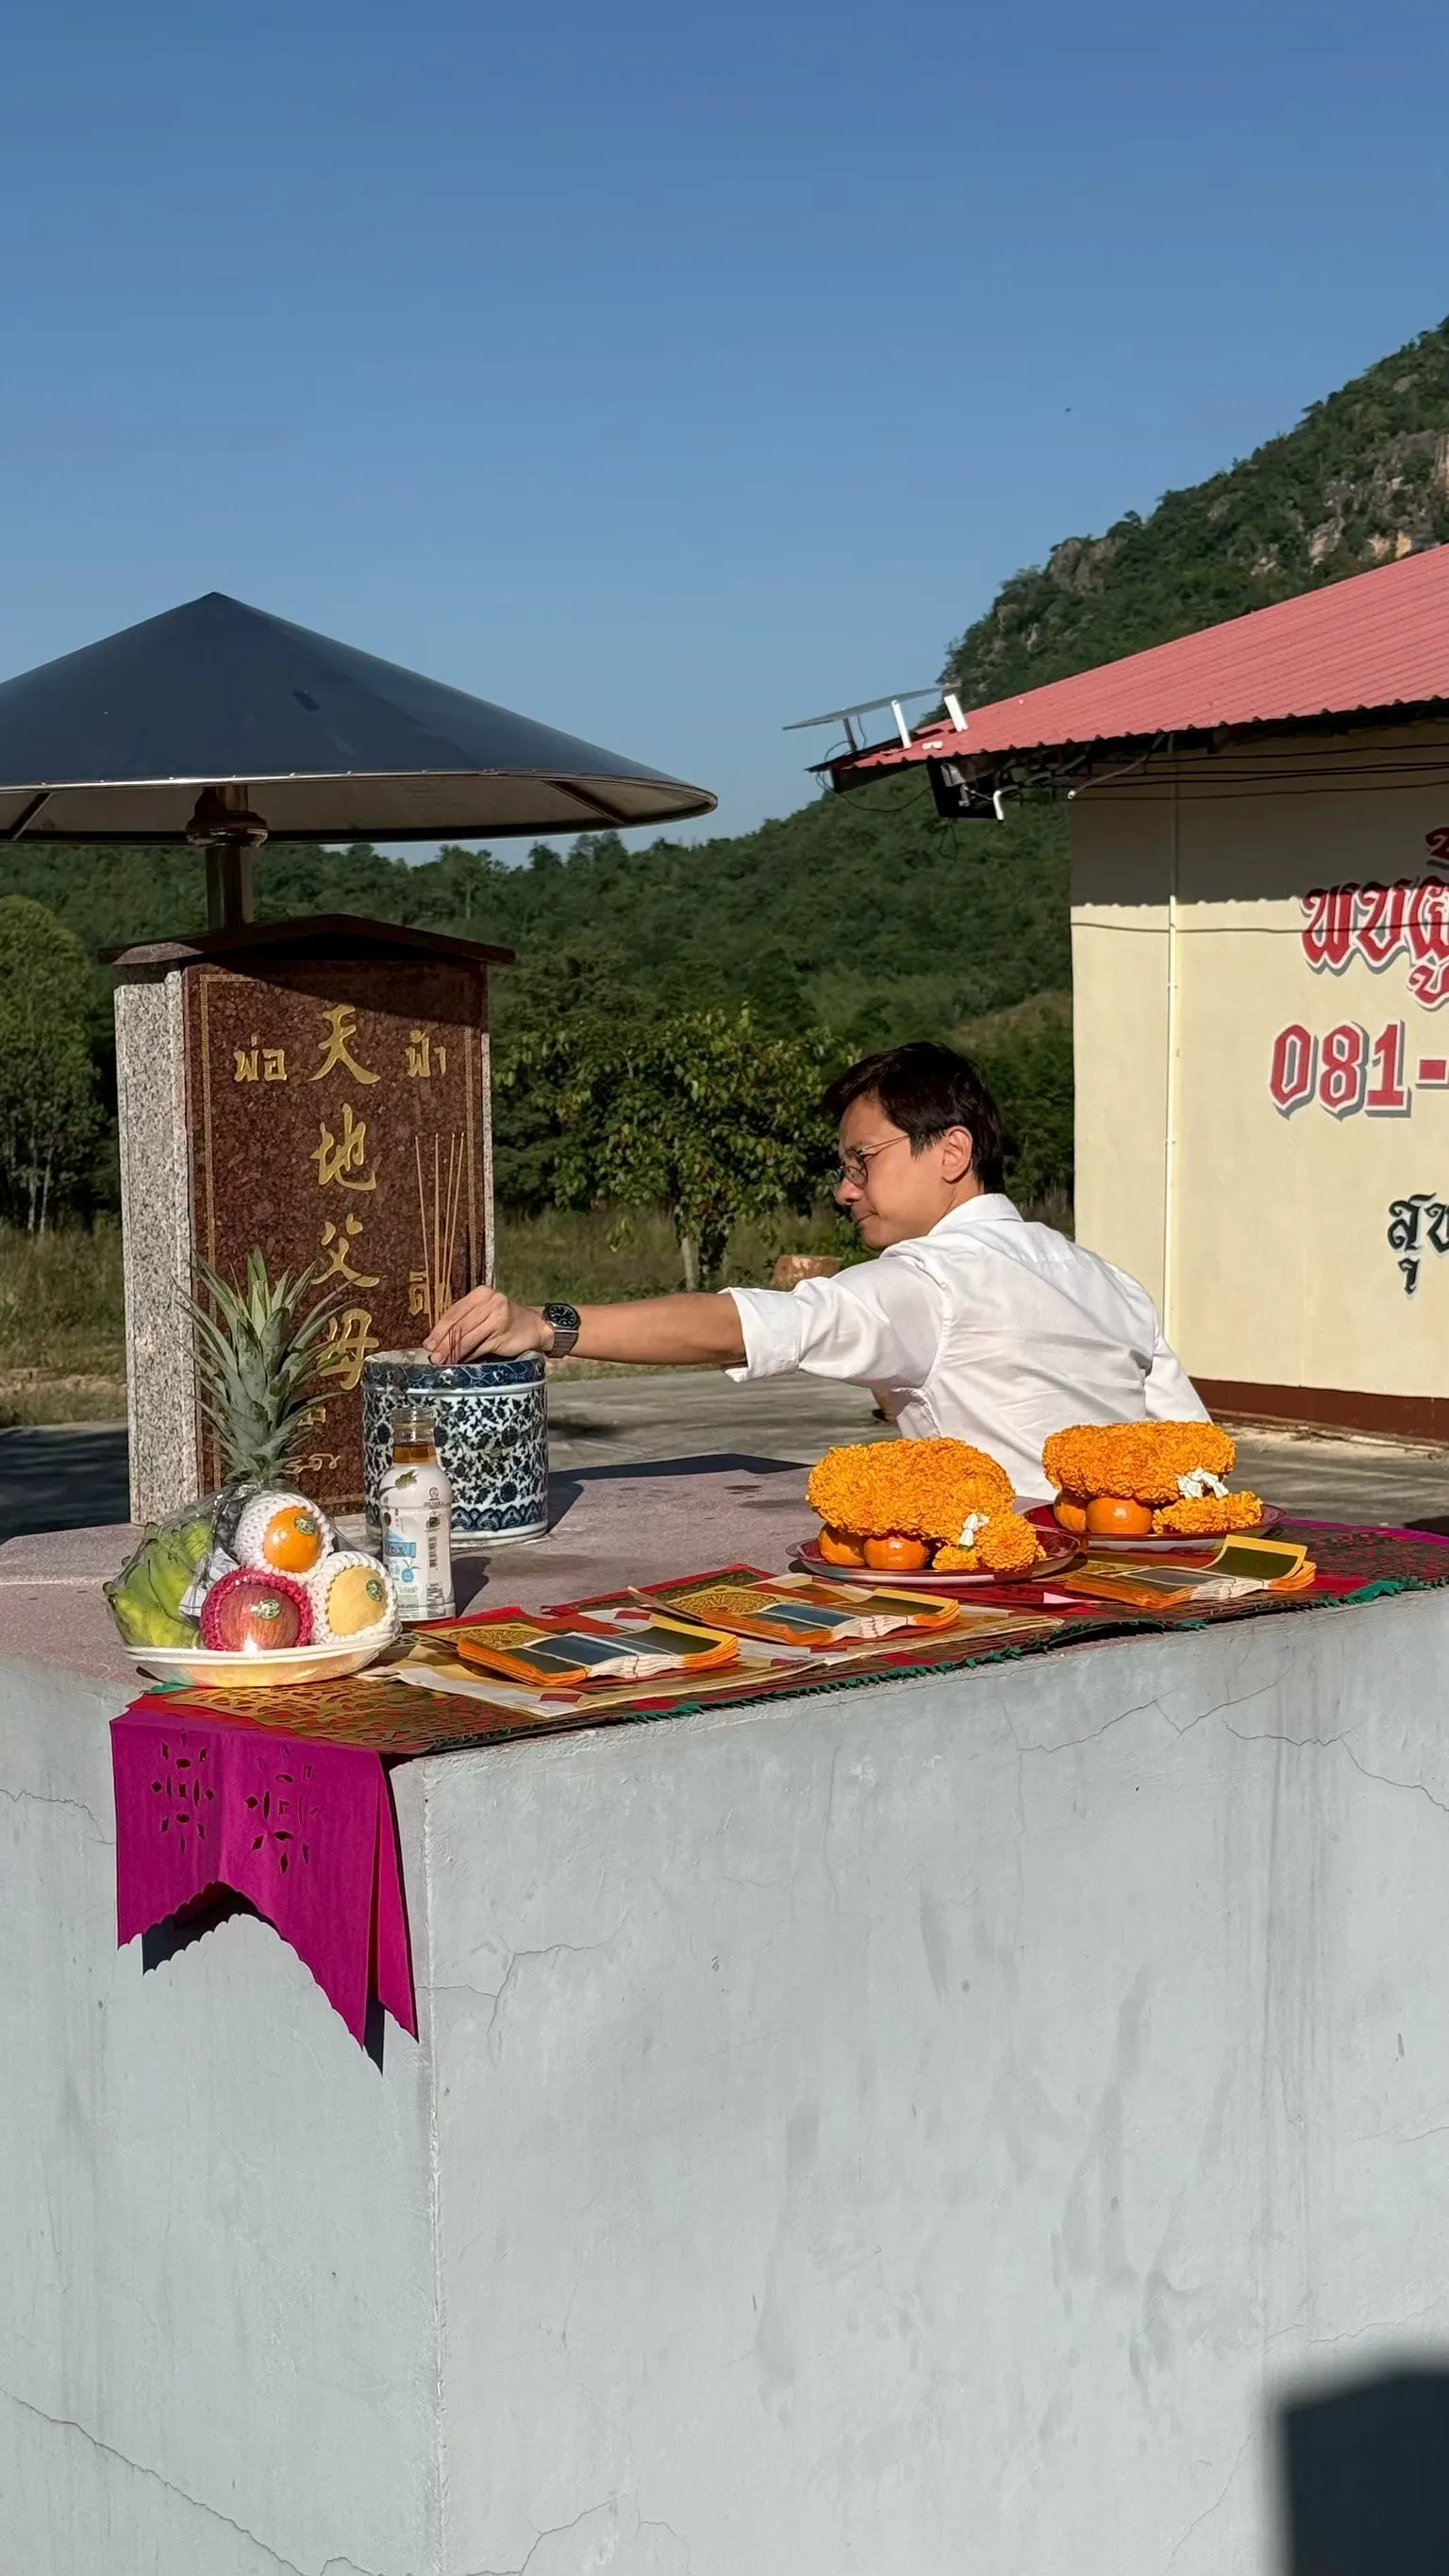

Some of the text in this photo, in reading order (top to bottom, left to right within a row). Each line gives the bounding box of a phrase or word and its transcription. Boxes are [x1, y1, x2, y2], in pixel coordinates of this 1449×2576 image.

[233, 1027, 448, 1082] พ่อ ฟ้า
[308, 1003, 380, 1392] 天地父母
